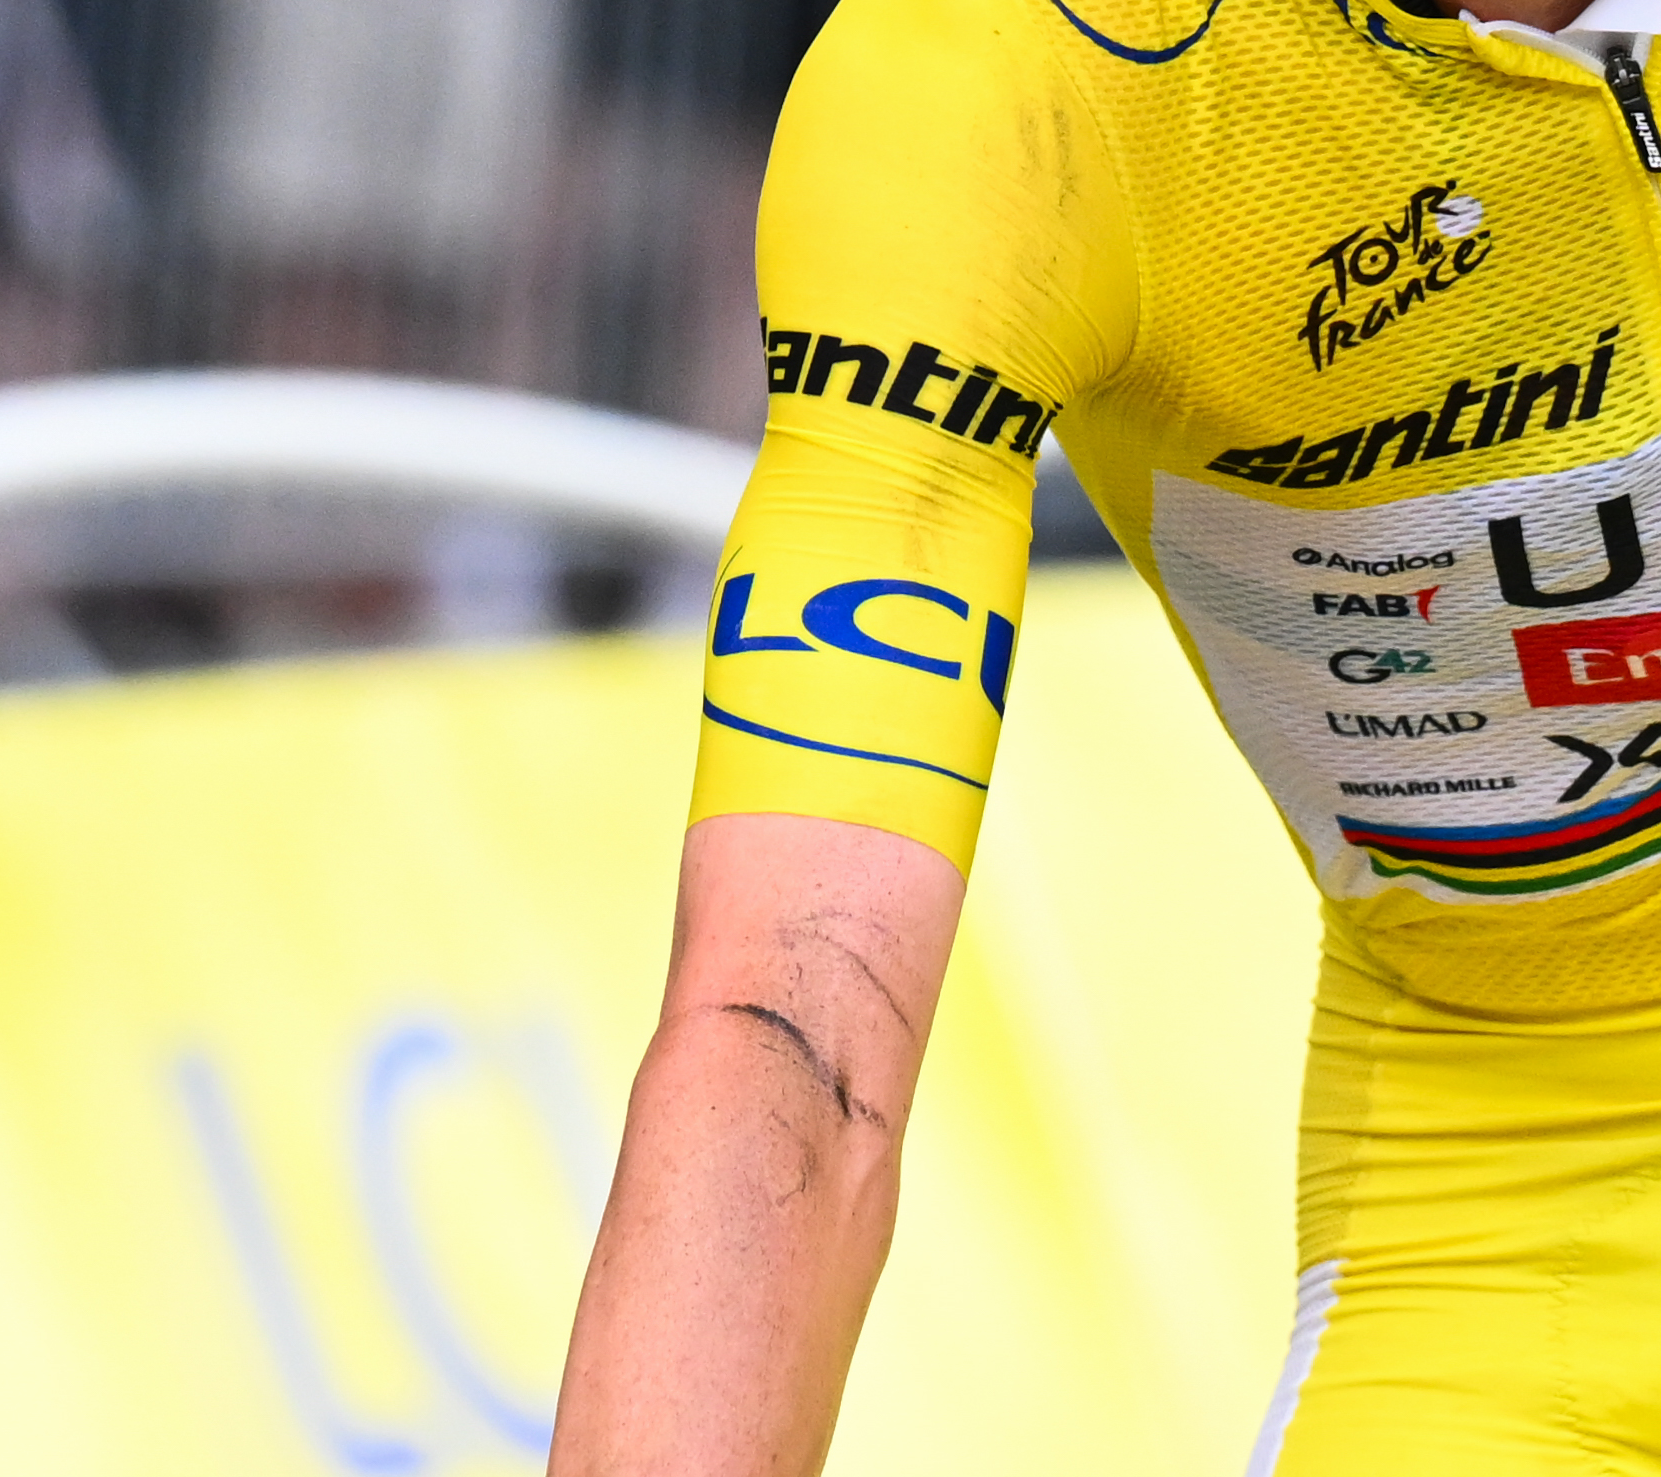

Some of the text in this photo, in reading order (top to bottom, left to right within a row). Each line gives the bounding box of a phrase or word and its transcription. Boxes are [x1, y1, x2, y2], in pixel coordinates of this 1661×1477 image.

[760, 317, 1064, 460] antini
[1205, 323, 1620, 489] santini
[1325, 547, 1455, 577] Analog
[1328, 647, 1436, 685] G42
[1339, 775, 1517, 798] RICHARD MILLE
